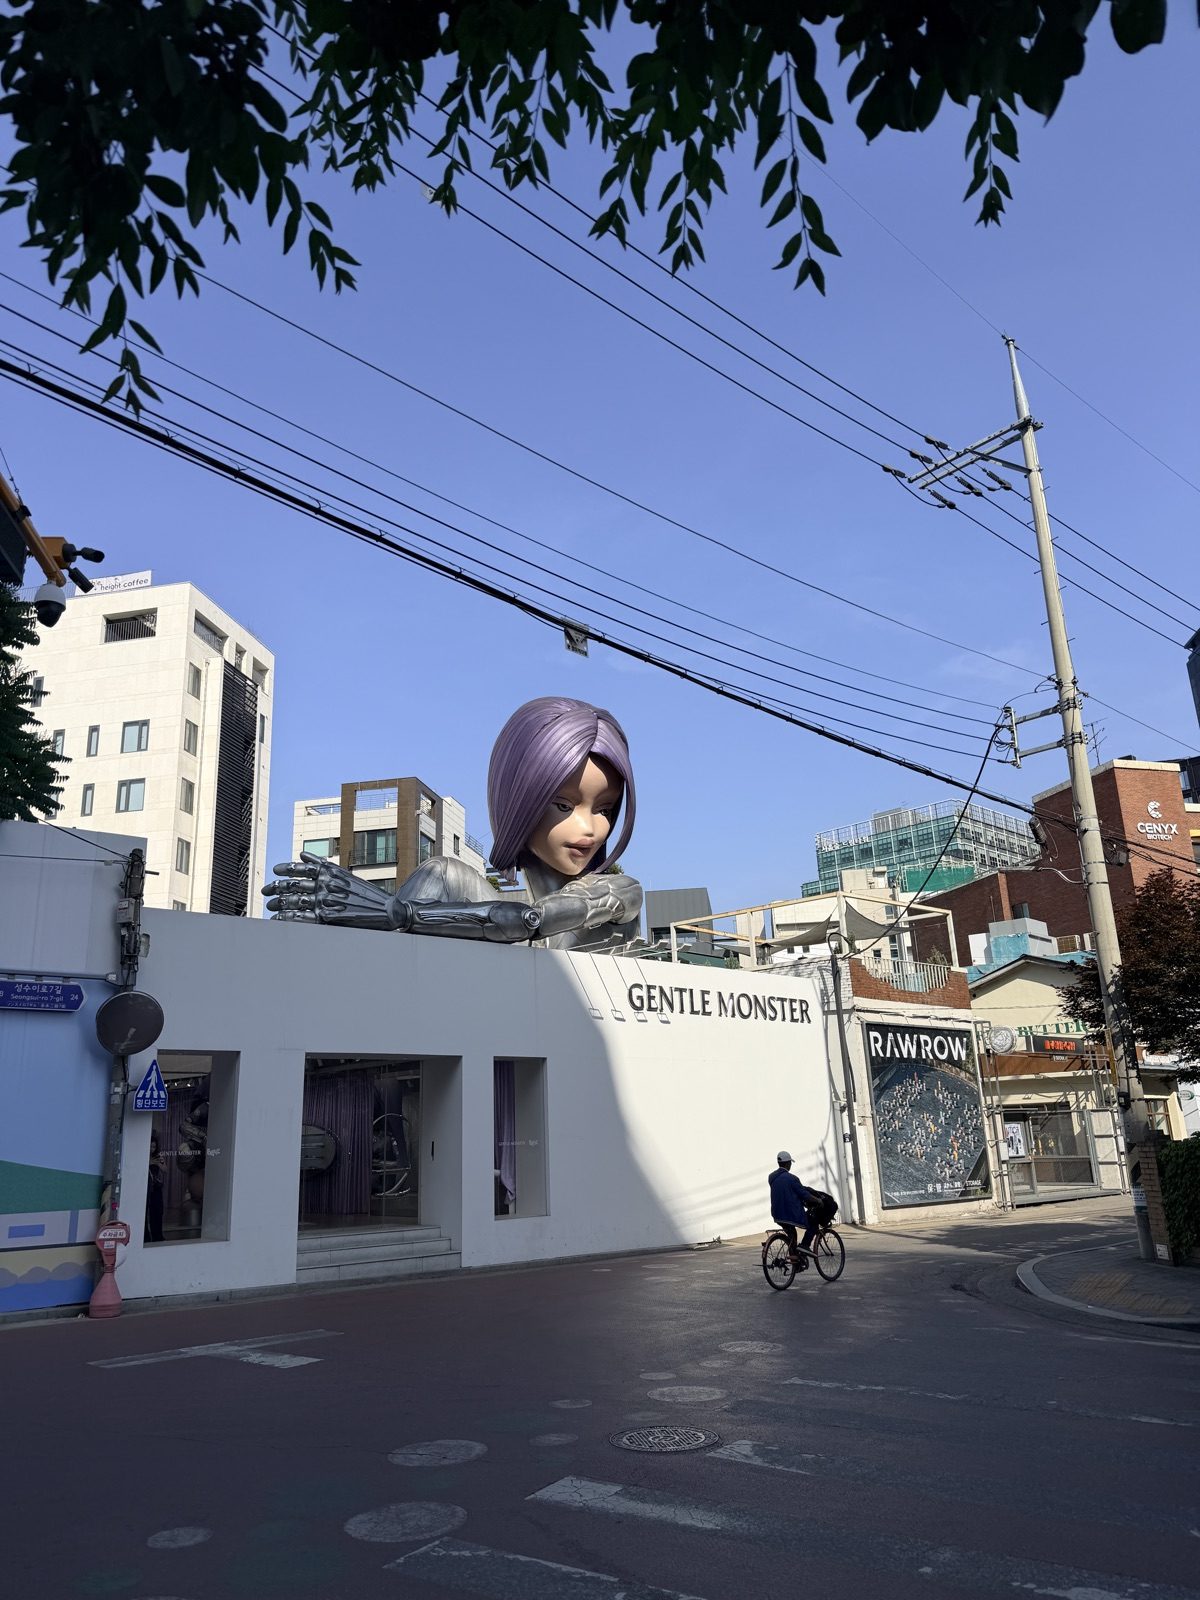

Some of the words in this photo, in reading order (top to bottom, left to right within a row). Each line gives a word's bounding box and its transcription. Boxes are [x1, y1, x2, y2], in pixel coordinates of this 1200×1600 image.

[100, 582, 122, 591] height
[122, 578, 149, 588] coffee
[1138, 822, 1178, 834] CENYX
[14, 983, 63, 995] 성수이로7길
[10, 993, 49, 1001] Seongsui-ro
[628, 983, 711, 1016] GENTLE
[716, 991, 811, 1024] MONSTER
[869, 1030, 967, 1061] RAWROW
[136, 1099, 166, 1109] 횡단보도
